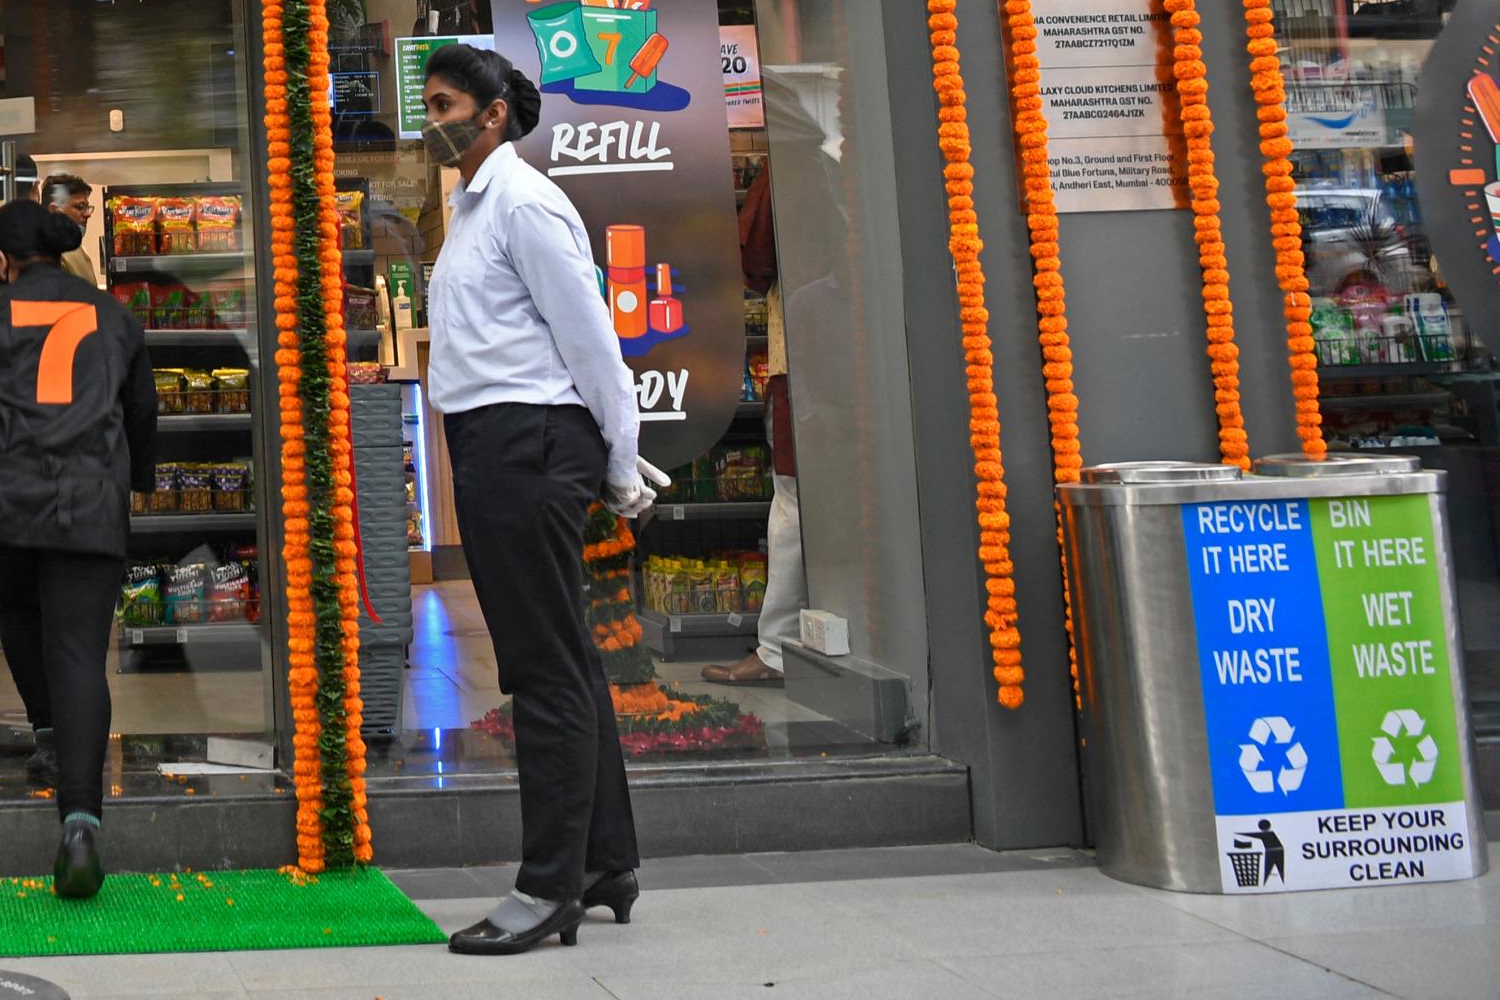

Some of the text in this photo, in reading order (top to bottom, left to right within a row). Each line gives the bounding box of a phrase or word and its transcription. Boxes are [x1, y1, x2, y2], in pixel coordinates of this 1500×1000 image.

[1043, 25, 1146, 37] MAHARASHTRA GST NO.
[1045, 14, 1107, 24] CONVENIENCE
[1107, 14, 1138, 23] RETAIL
[720, 43, 739, 56] AVE
[1040, 82, 1174, 95] LAXY CLOUD KITCHENS LIMITED
[1050, 96, 1153, 108] MAHARASHTRA GST NO.
[549, 120, 674, 161] REFILL
[333, 168, 358, 177] OKING
[1049, 169, 1061, 179] tul
[1061, 168, 1081, 178] Blue
[1081, 167, 1117, 178] Fortuna,
[1118, 165, 1150, 178] Military
[1061, 156, 1083, 167] No.3,
[1084, 155, 1115, 165] Ground
[1116, 155, 1132, 164] and
[1133, 153, 1153, 163] First
[1059, 179, 1092, 189] Andheri
[1092, 178, 1114, 189] East,
[1115, 177, 1148, 188] Mumbai
[10, 299, 98, 405] 7
[635, 368, 690, 411] DY
[1198, 503, 1302, 535] RECYCLE
[1328, 500, 1372, 529] BIN
[1202, 543, 1290, 574] IT HERE
[1333, 537, 1427, 568] IT HERE
[1228, 598, 1276, 635] DRY
[1362, 591, 1413, 628] WET
[1214, 647, 1303, 685] WASTE
[1352, 640, 1436, 678] WASTE
[1317, 810, 1447, 835] KEEP YOUR
[1301, 832, 1465, 860] SURROUNDING
[1348, 860, 1426, 882] CLEAN
